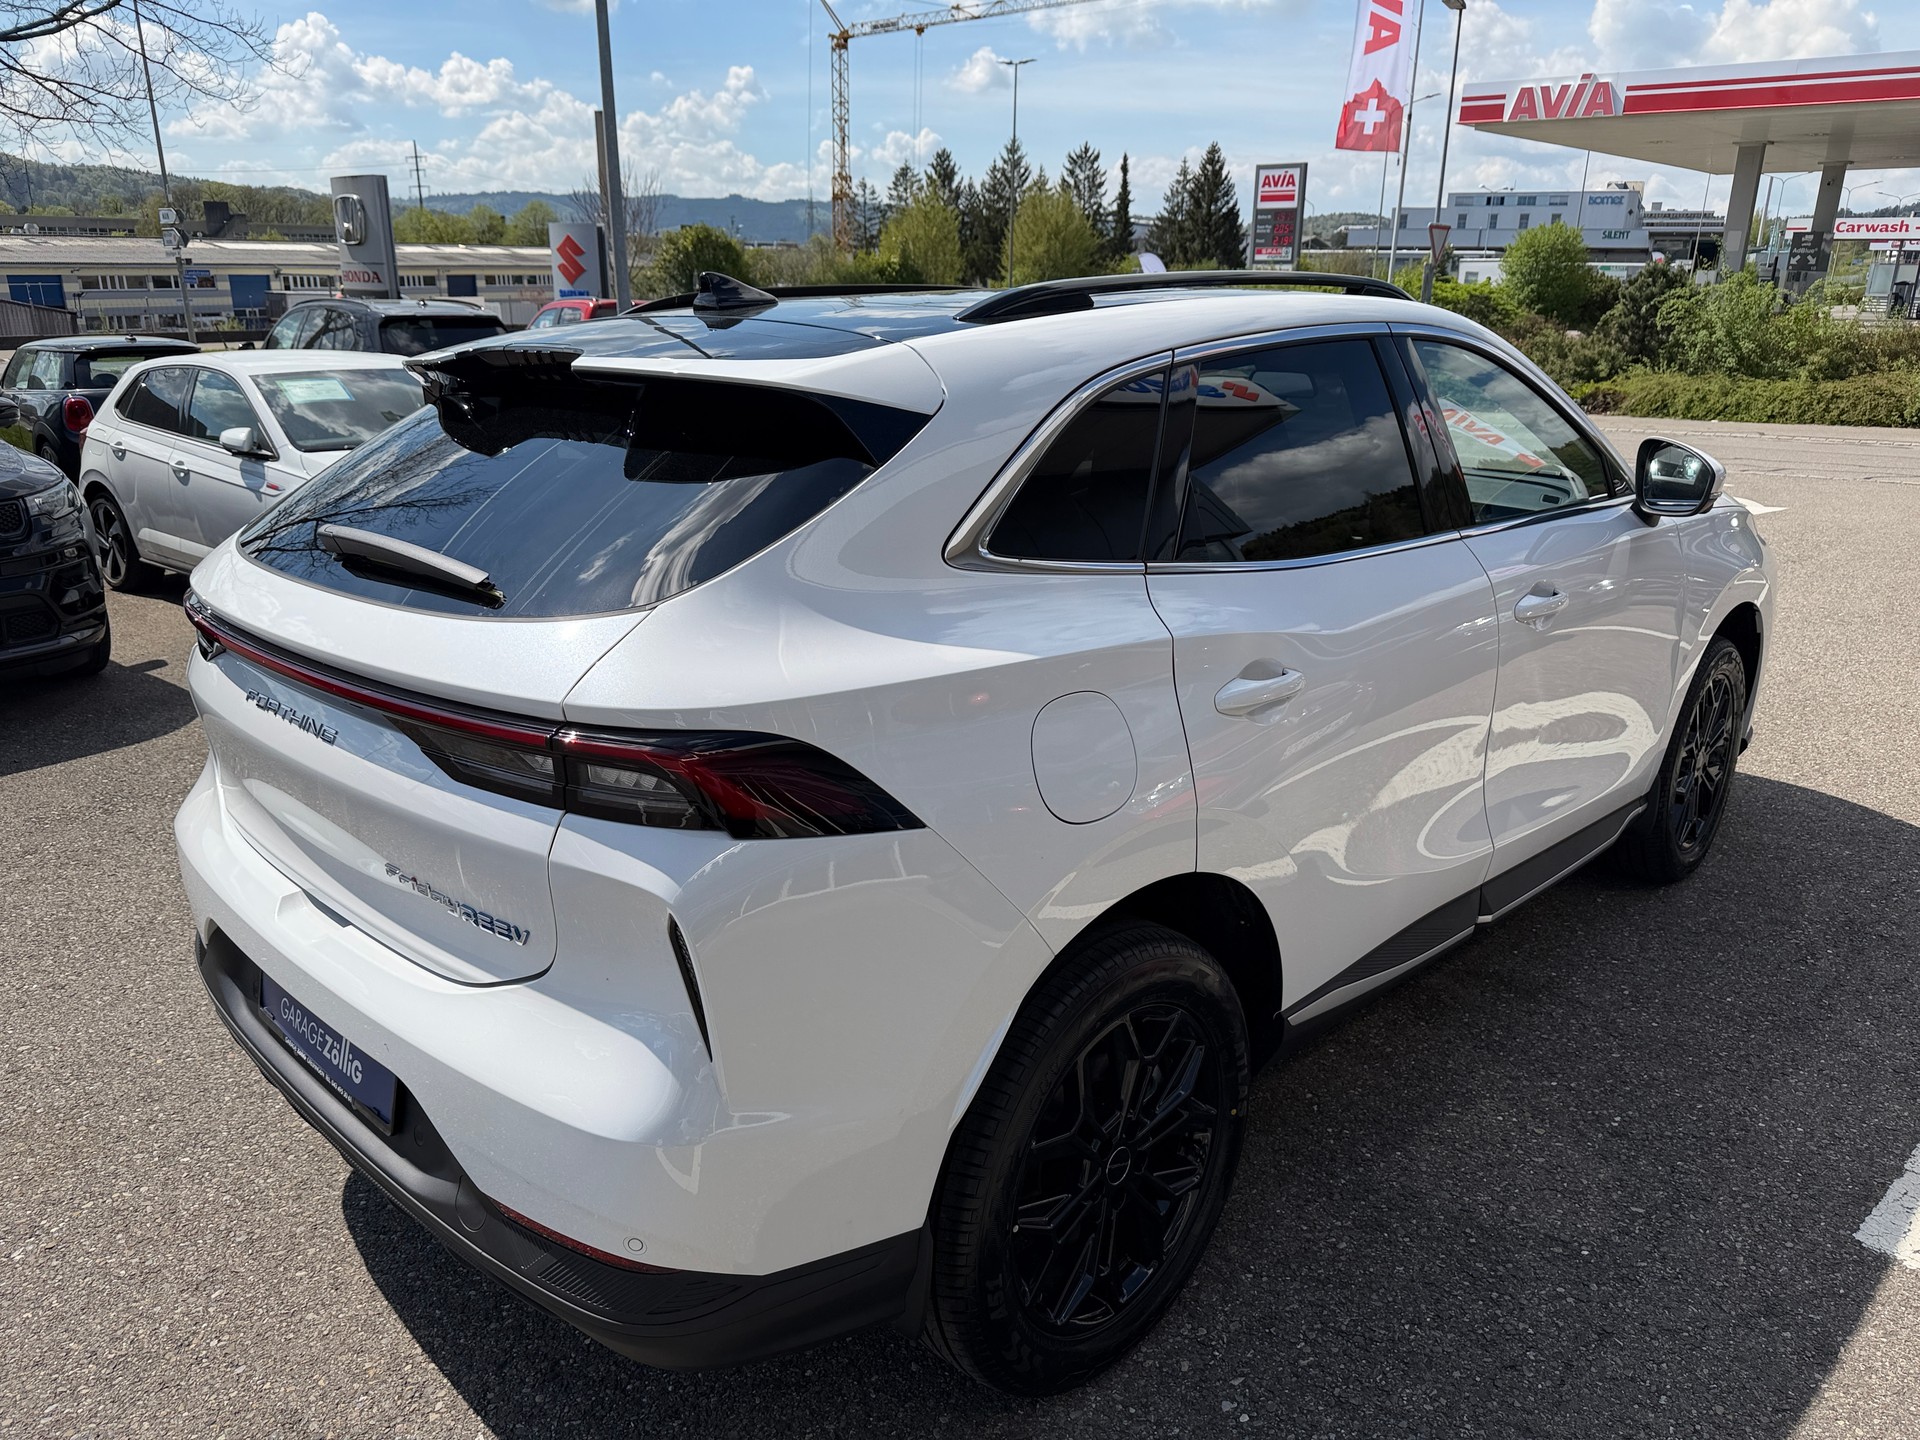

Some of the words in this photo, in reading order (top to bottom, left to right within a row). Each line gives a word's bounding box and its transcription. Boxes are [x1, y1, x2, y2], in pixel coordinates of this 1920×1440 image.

[1507, 73, 1615, 121] AVIA
[1261, 171, 1296, 188] AVIA
[1836, 219, 1910, 233] Carwash
[1602, 230, 1631, 239] SILENT
[342, 270, 383, 283] HONDA
[245, 688, 339, 747] FORTHING
